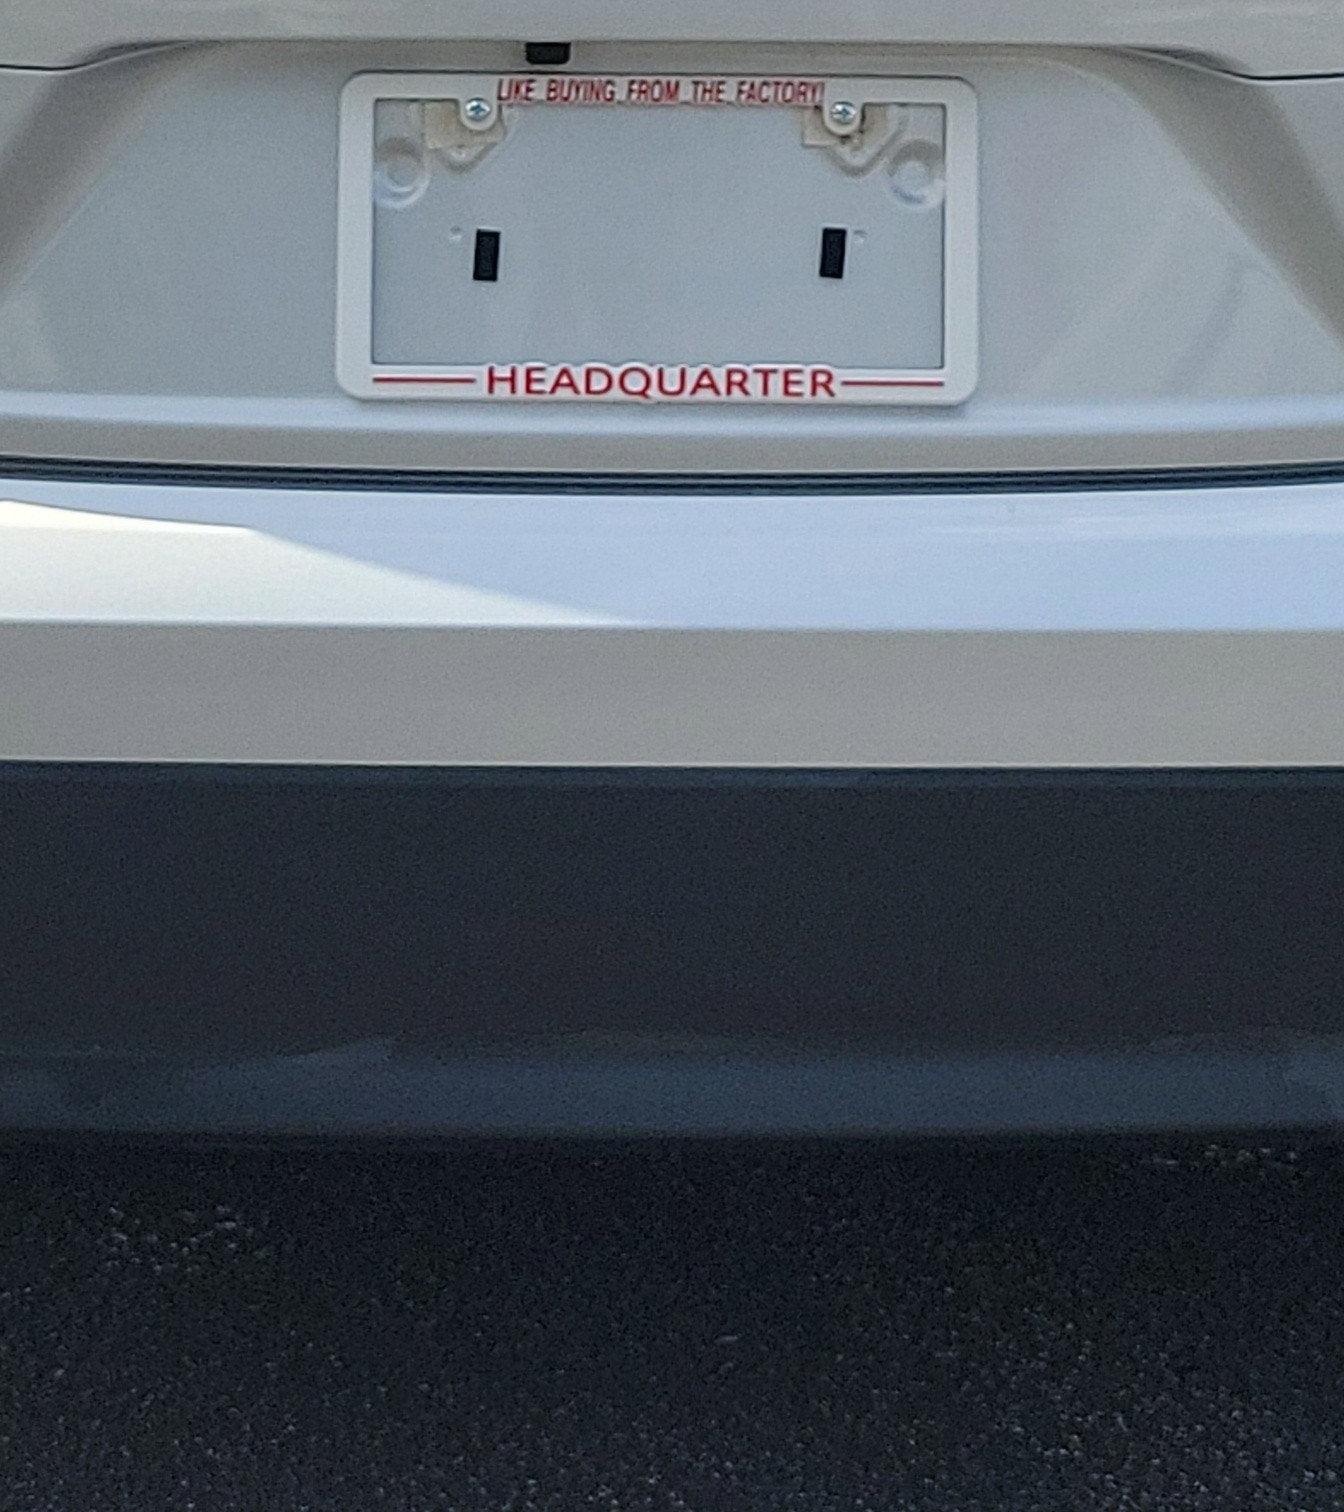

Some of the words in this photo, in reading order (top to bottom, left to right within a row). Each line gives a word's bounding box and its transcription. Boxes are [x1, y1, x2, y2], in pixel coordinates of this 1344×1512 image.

[497, 78, 536, 102] LIKE
[546, 79, 616, 103] BUYING
[626, 79, 680, 103] FROM
[692, 79, 726, 104] THE
[486, 366, 836, 399] HEADQUARTER
